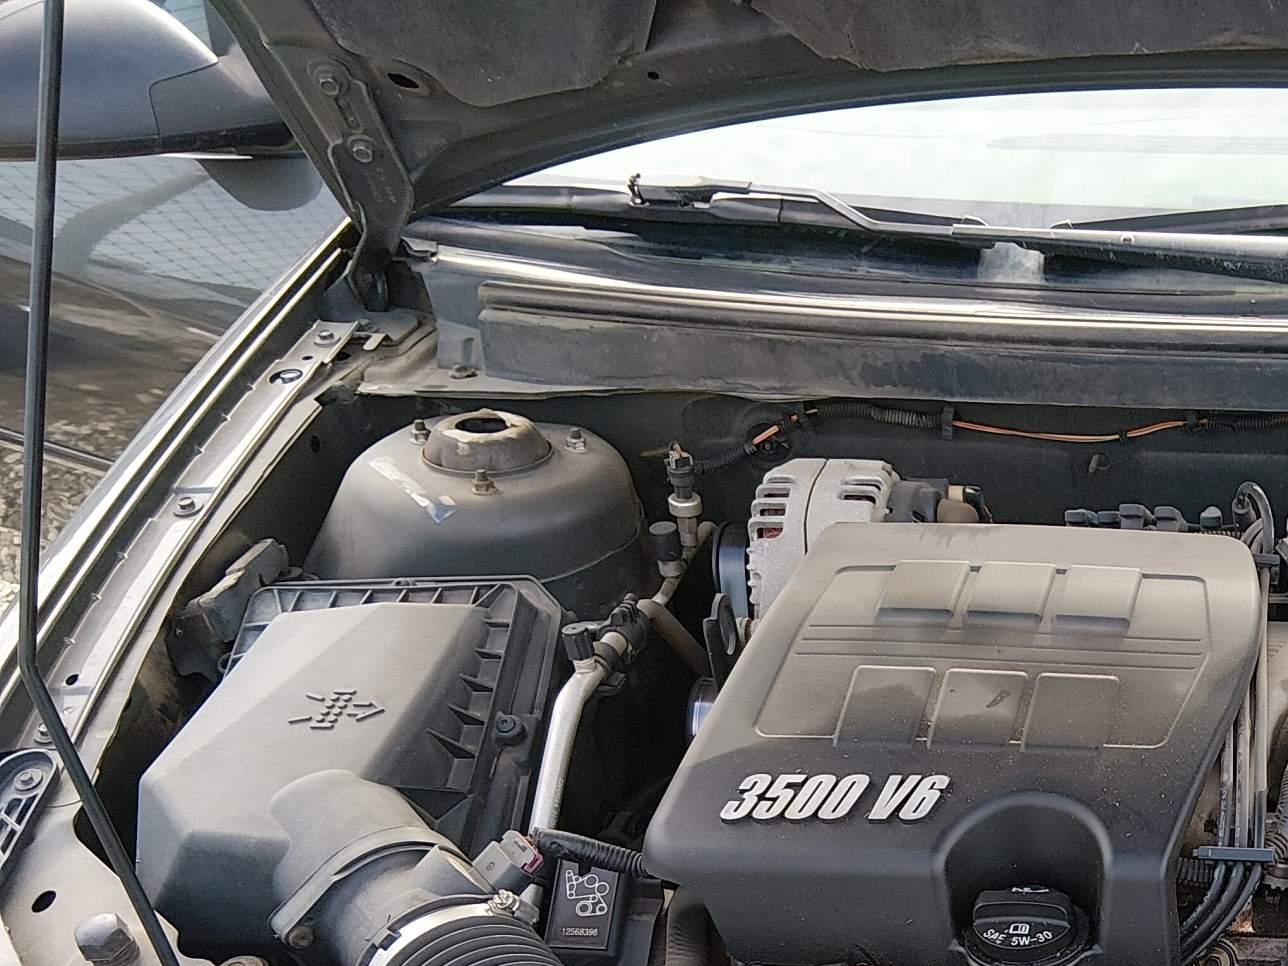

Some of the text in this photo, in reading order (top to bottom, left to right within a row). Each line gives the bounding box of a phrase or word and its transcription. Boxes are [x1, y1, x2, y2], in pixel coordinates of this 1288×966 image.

[719, 773, 951, 820] 3500 V6
[561, 927, 598, 936] 12568396
[983, 929, 1053, 946] SAE 5W-30
